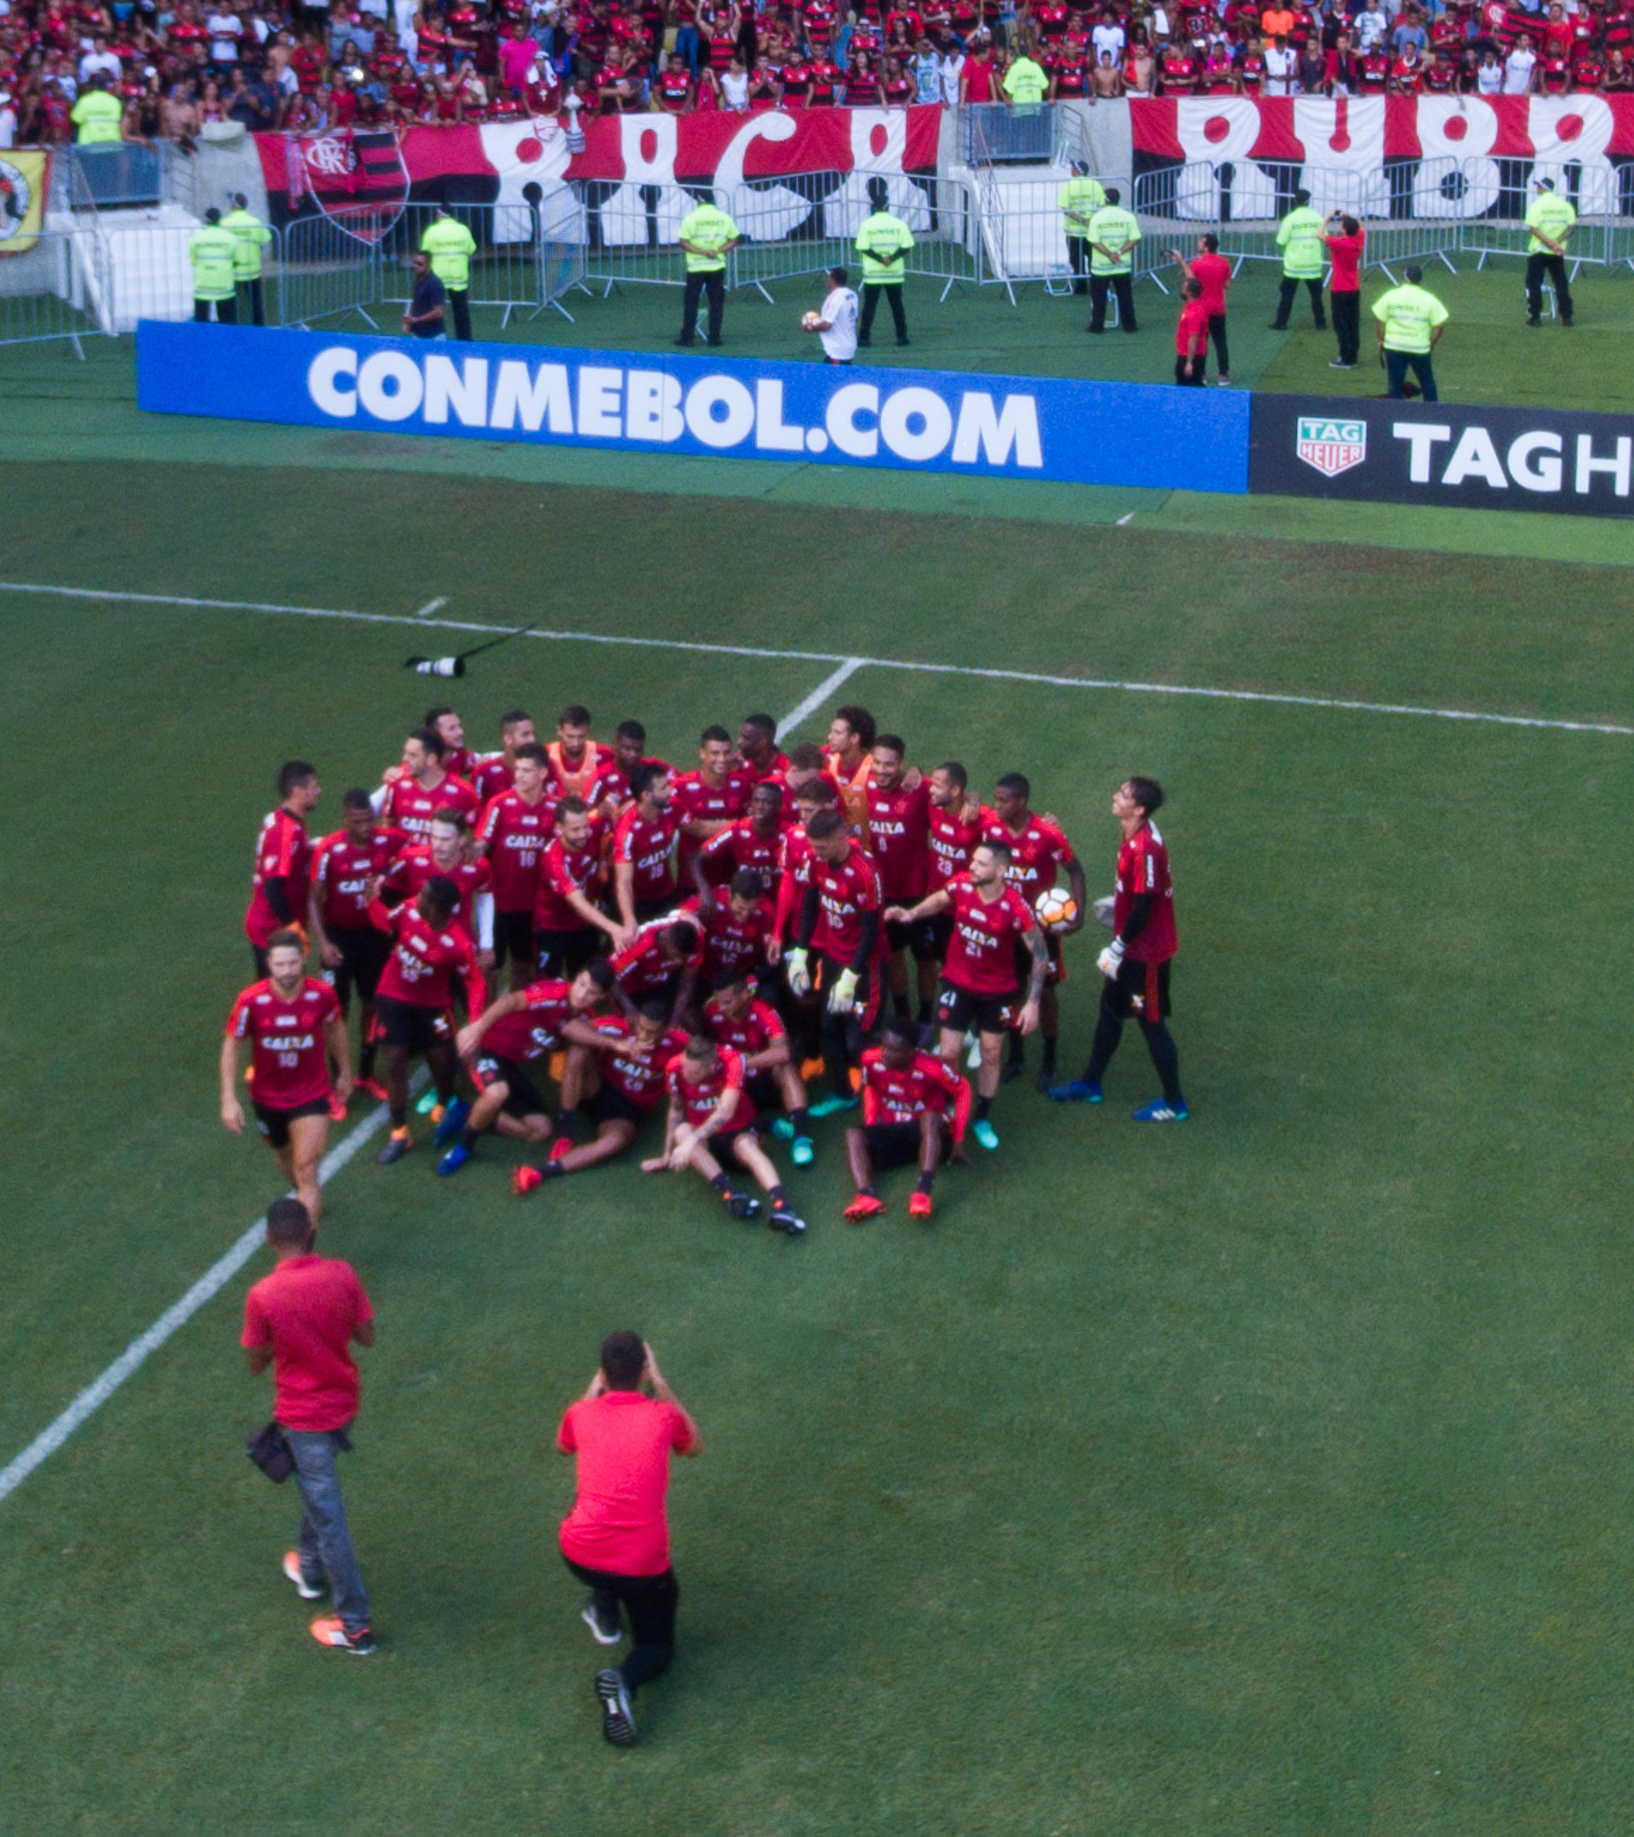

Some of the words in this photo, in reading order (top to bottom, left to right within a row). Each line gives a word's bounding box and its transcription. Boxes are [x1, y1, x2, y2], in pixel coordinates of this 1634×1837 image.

[308, 347, 1044, 468] CONMEBOL.COM
[1303, 422, 1360, 443] TAG
[1301, 444, 1362, 471] HEUER
[505, 835, 546, 849] CAIXA
[940, 990, 957, 1007] 21
[262, 1035, 314, 1049] CAIXA
